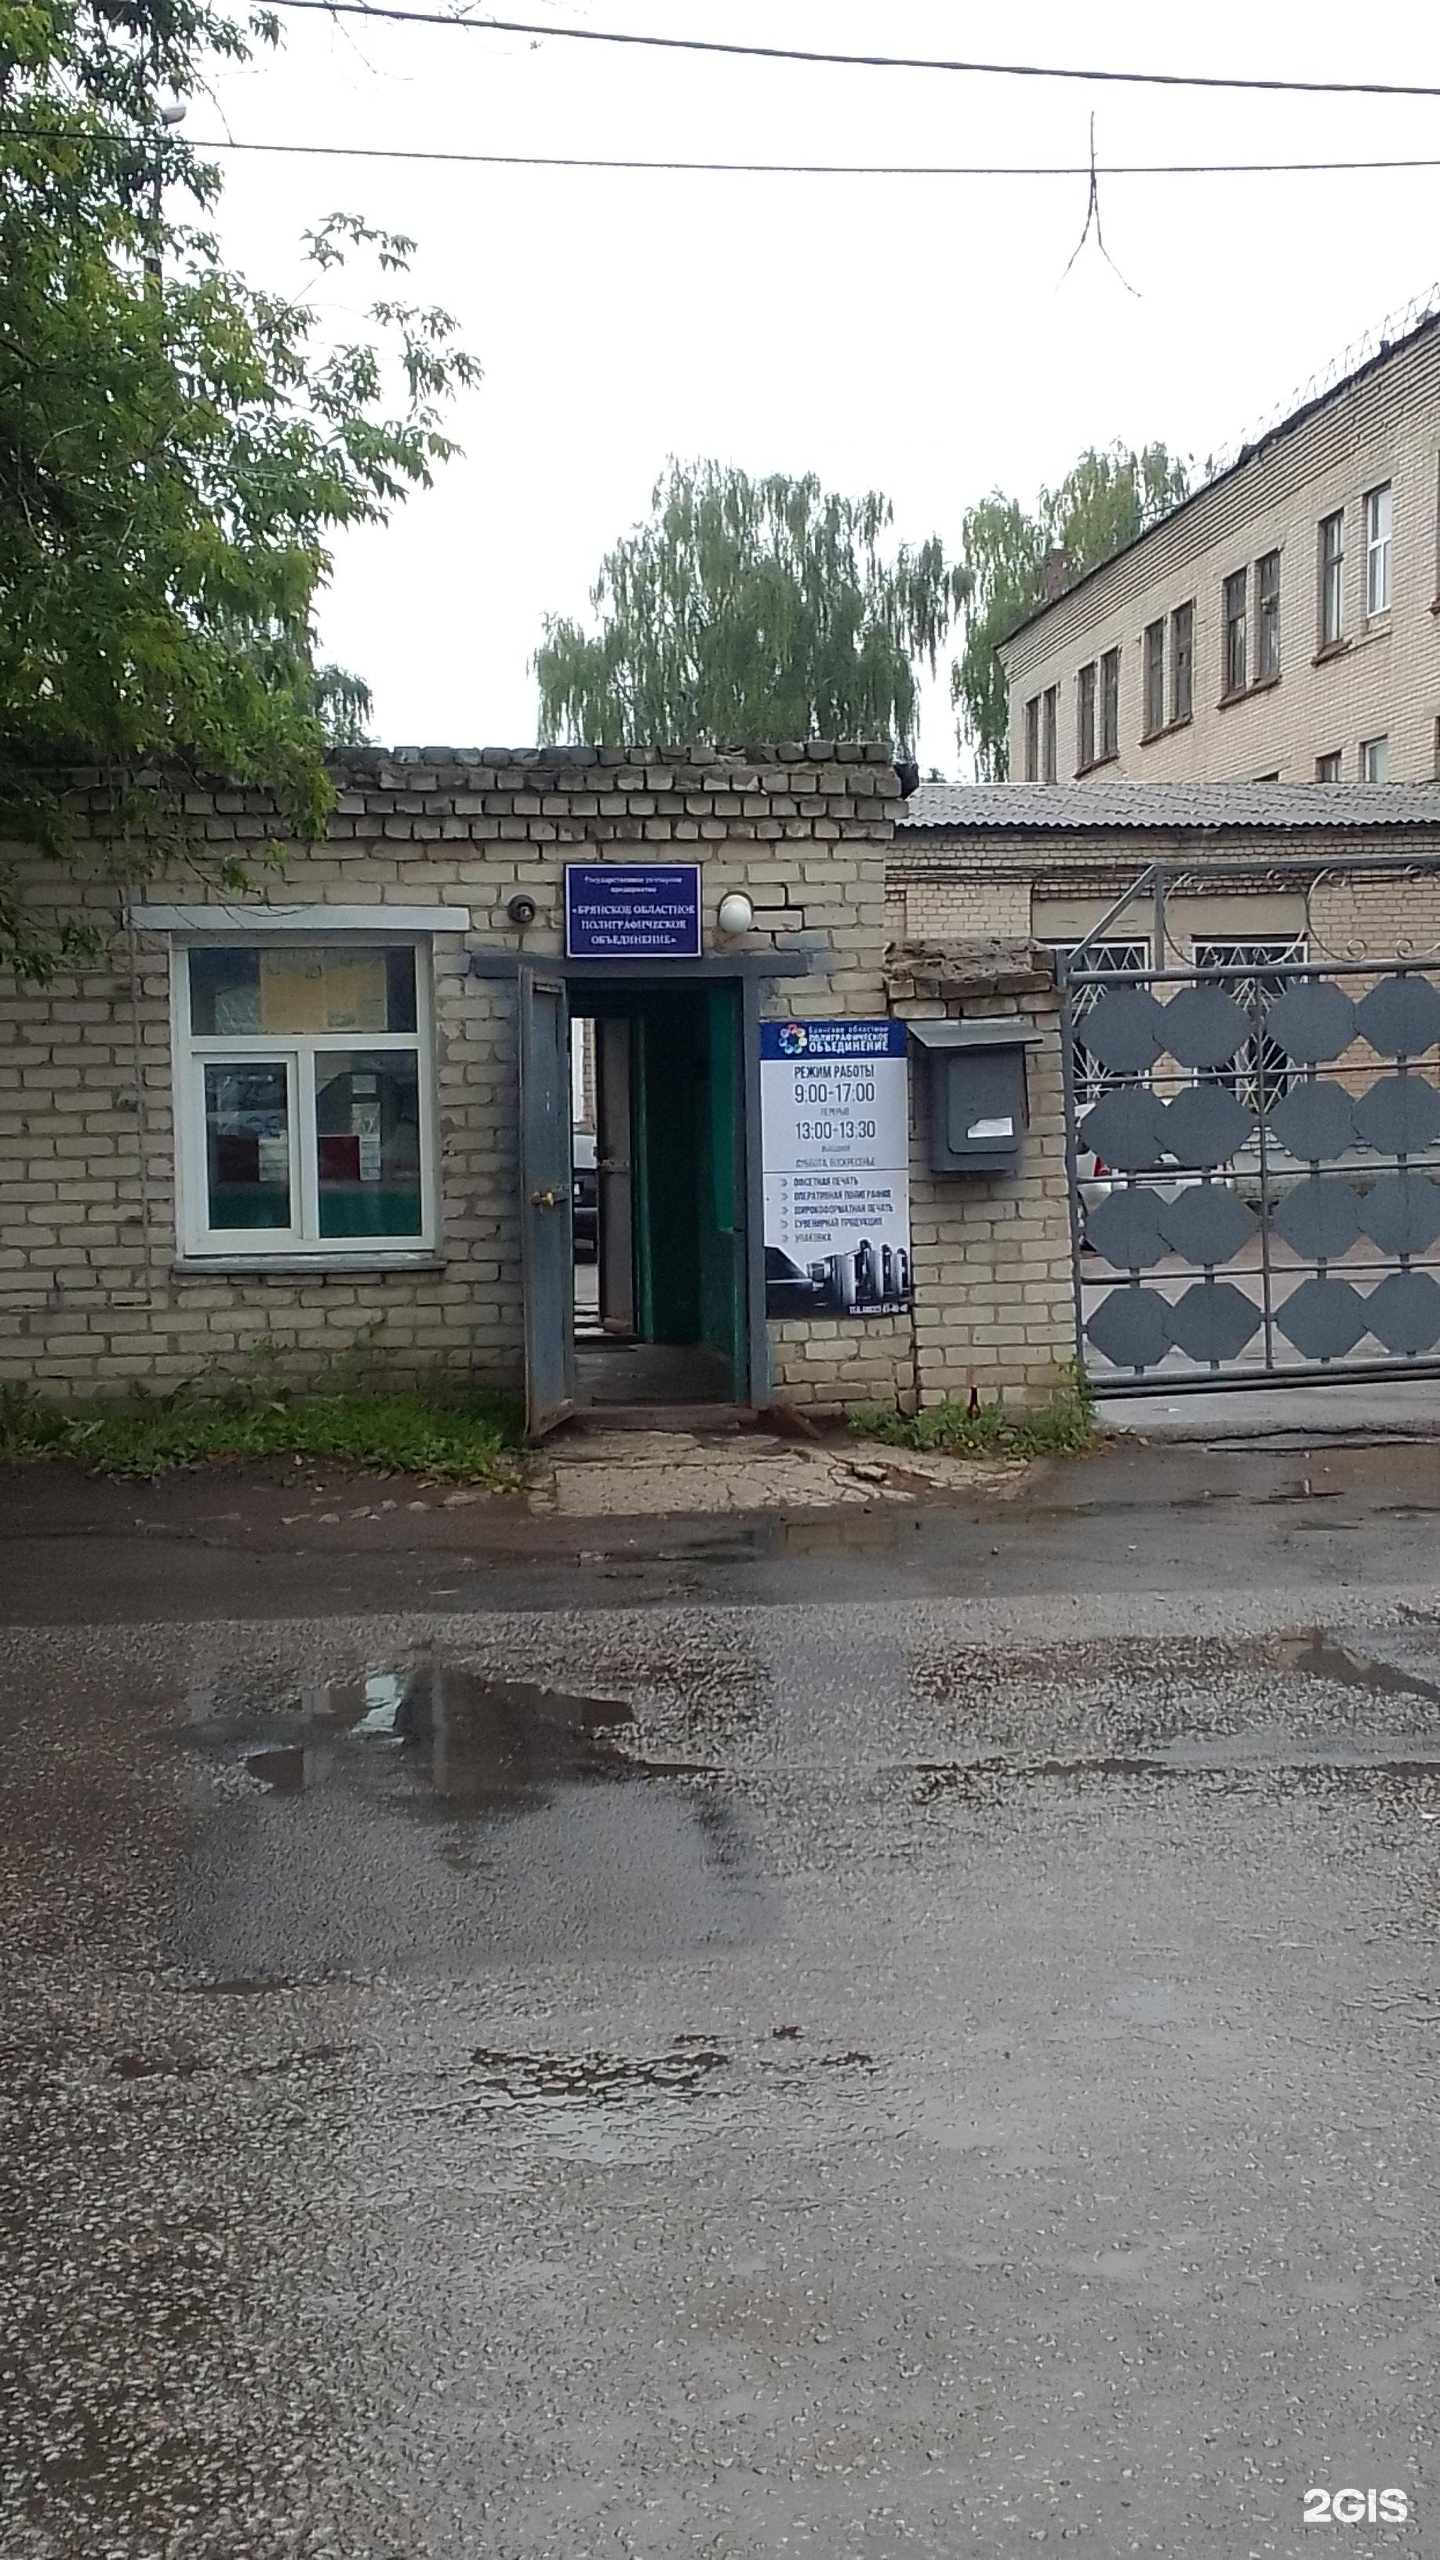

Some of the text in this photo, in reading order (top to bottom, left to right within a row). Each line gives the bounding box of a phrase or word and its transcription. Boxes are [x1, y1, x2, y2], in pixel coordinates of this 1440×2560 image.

[633, 905, 695, 914] ОБЛАСТНОЕ
[581, 920, 687, 929] ПОЛИГРАФИЧЕСКОЕ
[808, 1033, 889, 1042] ПОЛИГРАФИЧЕСКОЕ
[808, 1042, 889, 1054] ОБЪЕДИНЕНИЕ
[794, 1064, 874, 1078] РЕЖИМ РАБОТЫ
[794, 1083, 875, 1103] 9:00-17:00
[795, 1120, 876, 1139] 13:00-13:30
[832, 1176, 858, 1186] ПЕЧАТЬ
[794, 1191, 842, 1200] ОПЕРАТИВНАЯ
[867, 1204, 894, 1213] ПЕЧАТЬ
[794, 1218, 840, 1228] СУВЕНИРНАЯ
